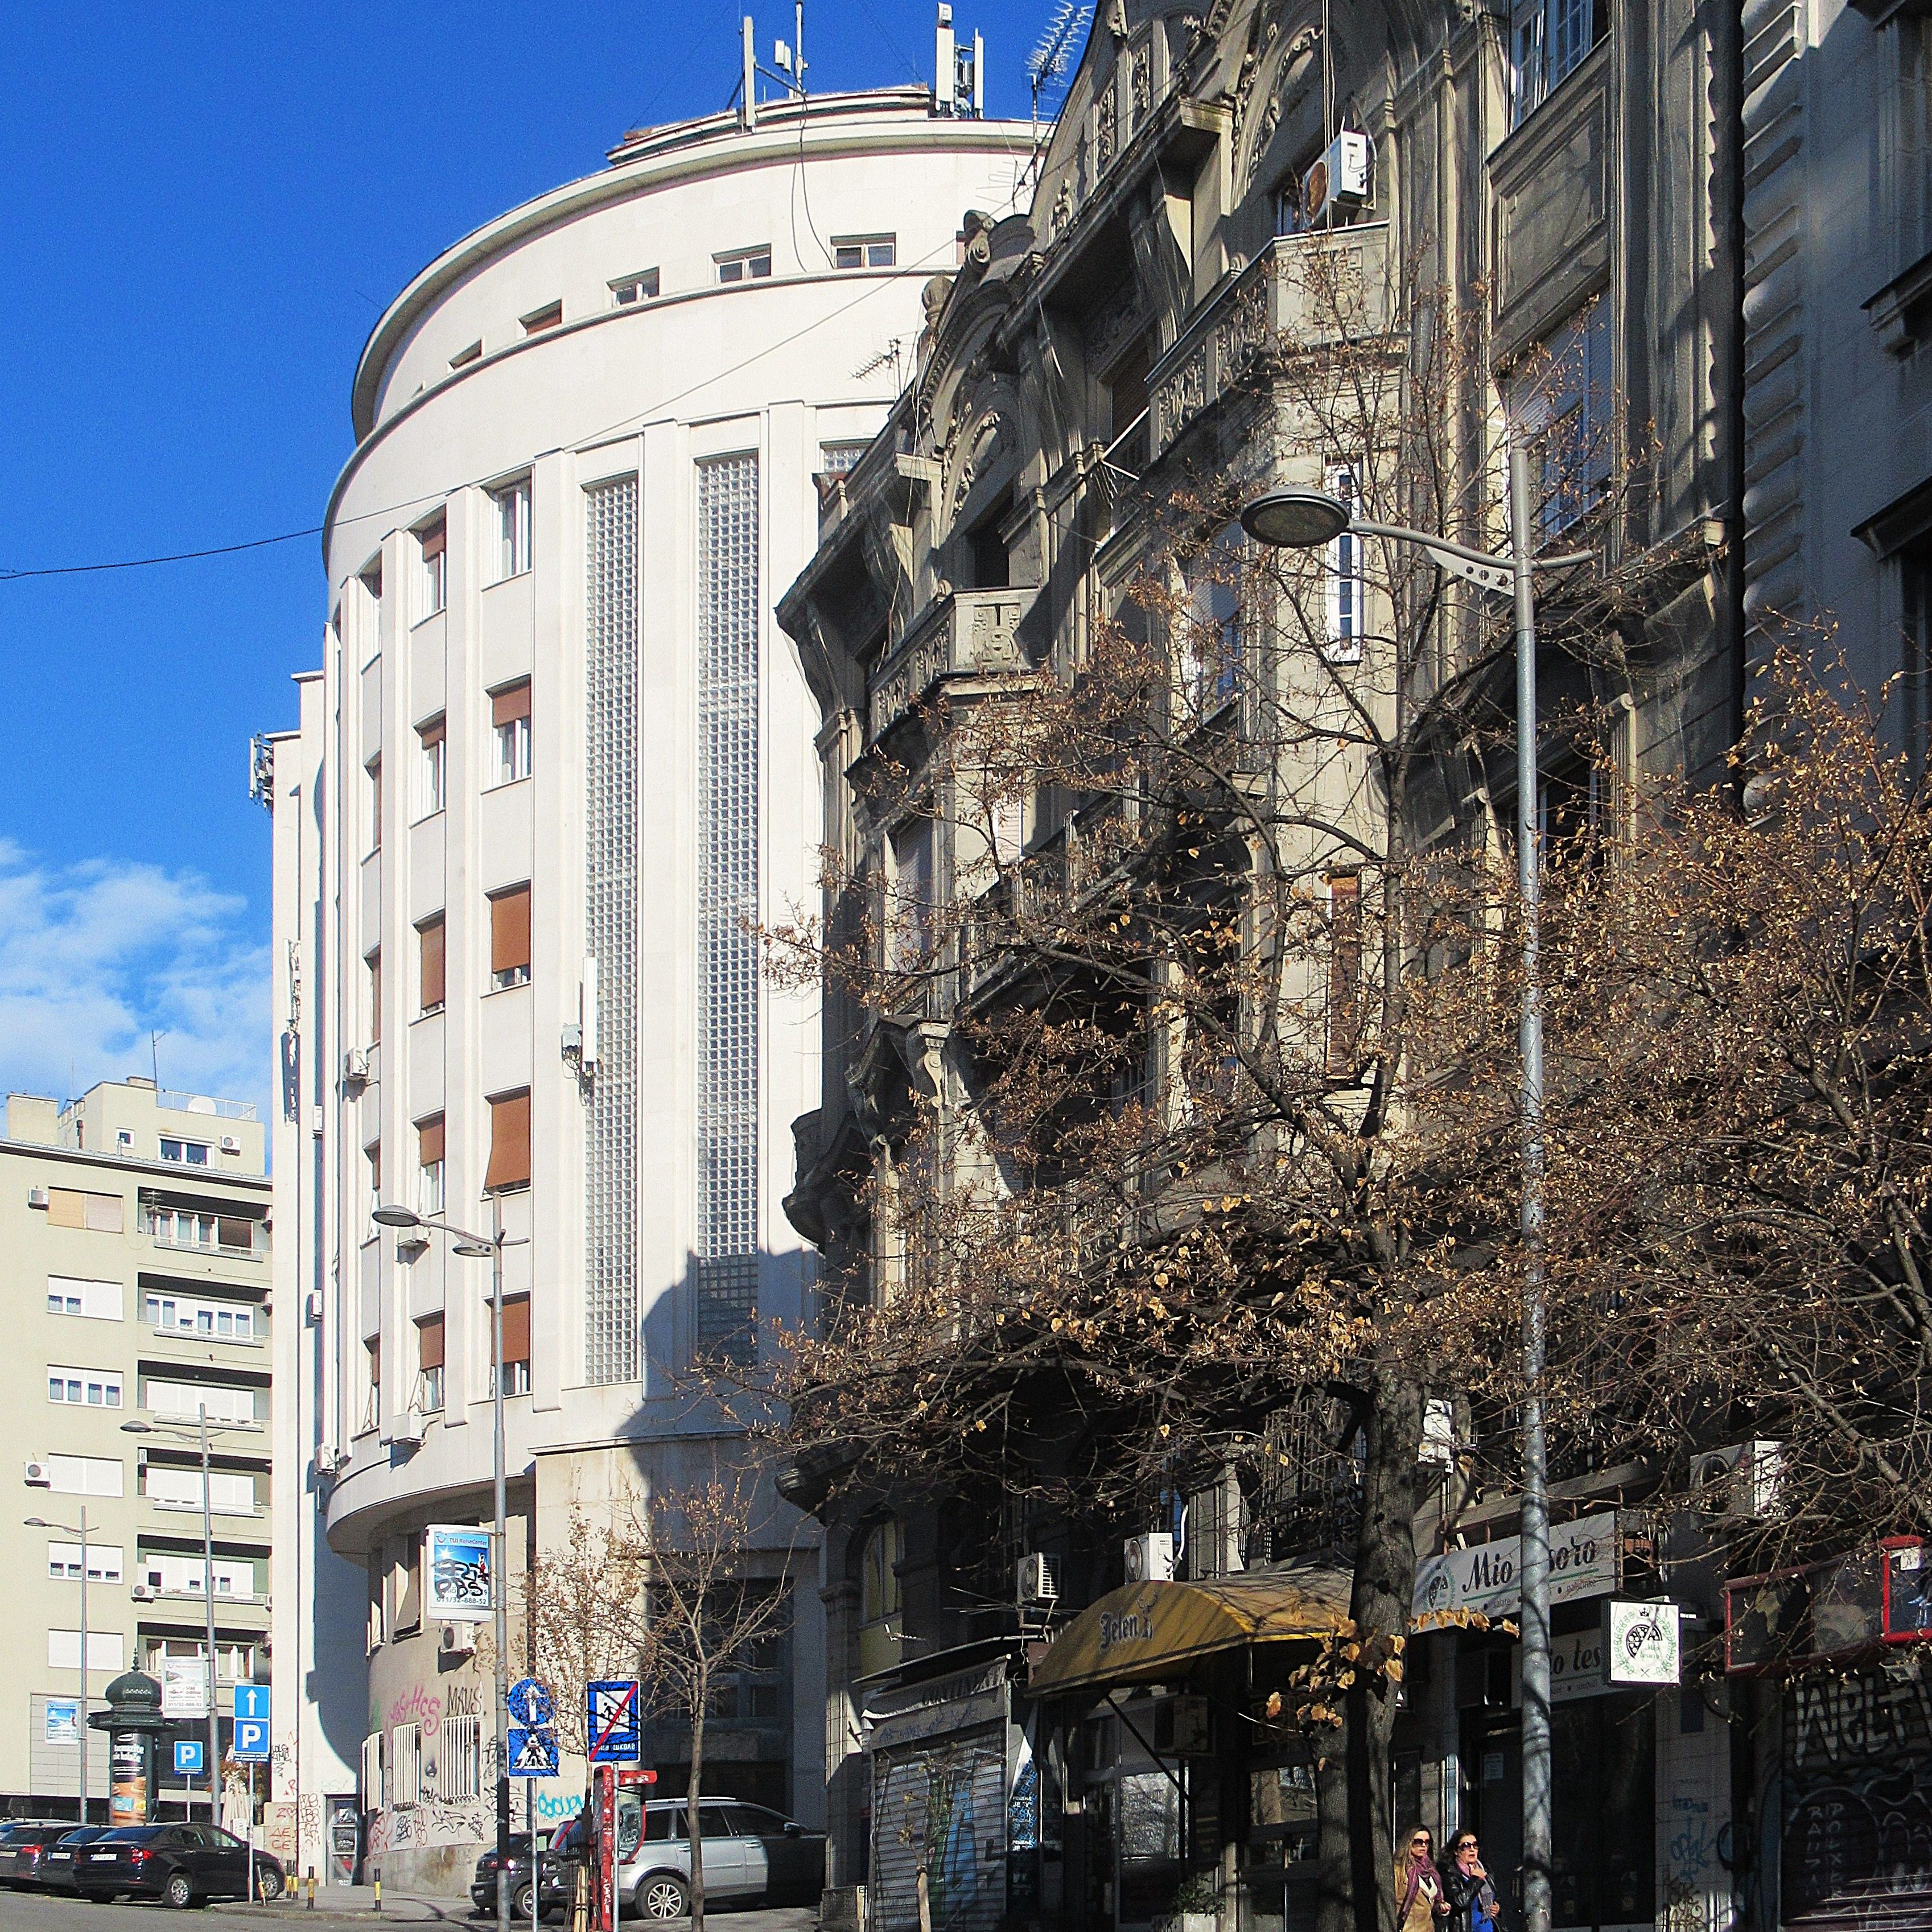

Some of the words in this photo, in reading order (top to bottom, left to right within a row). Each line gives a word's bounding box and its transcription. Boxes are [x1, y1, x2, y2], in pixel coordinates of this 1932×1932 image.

[1462, 1551, 1513, 1592] Mio
[1549, 1536, 1596, 1572] soro
[1099, 1610, 1138, 1649] Jelen
[242, 1724, 262, 1749] P
[181, 1745, 196, 1764] P
